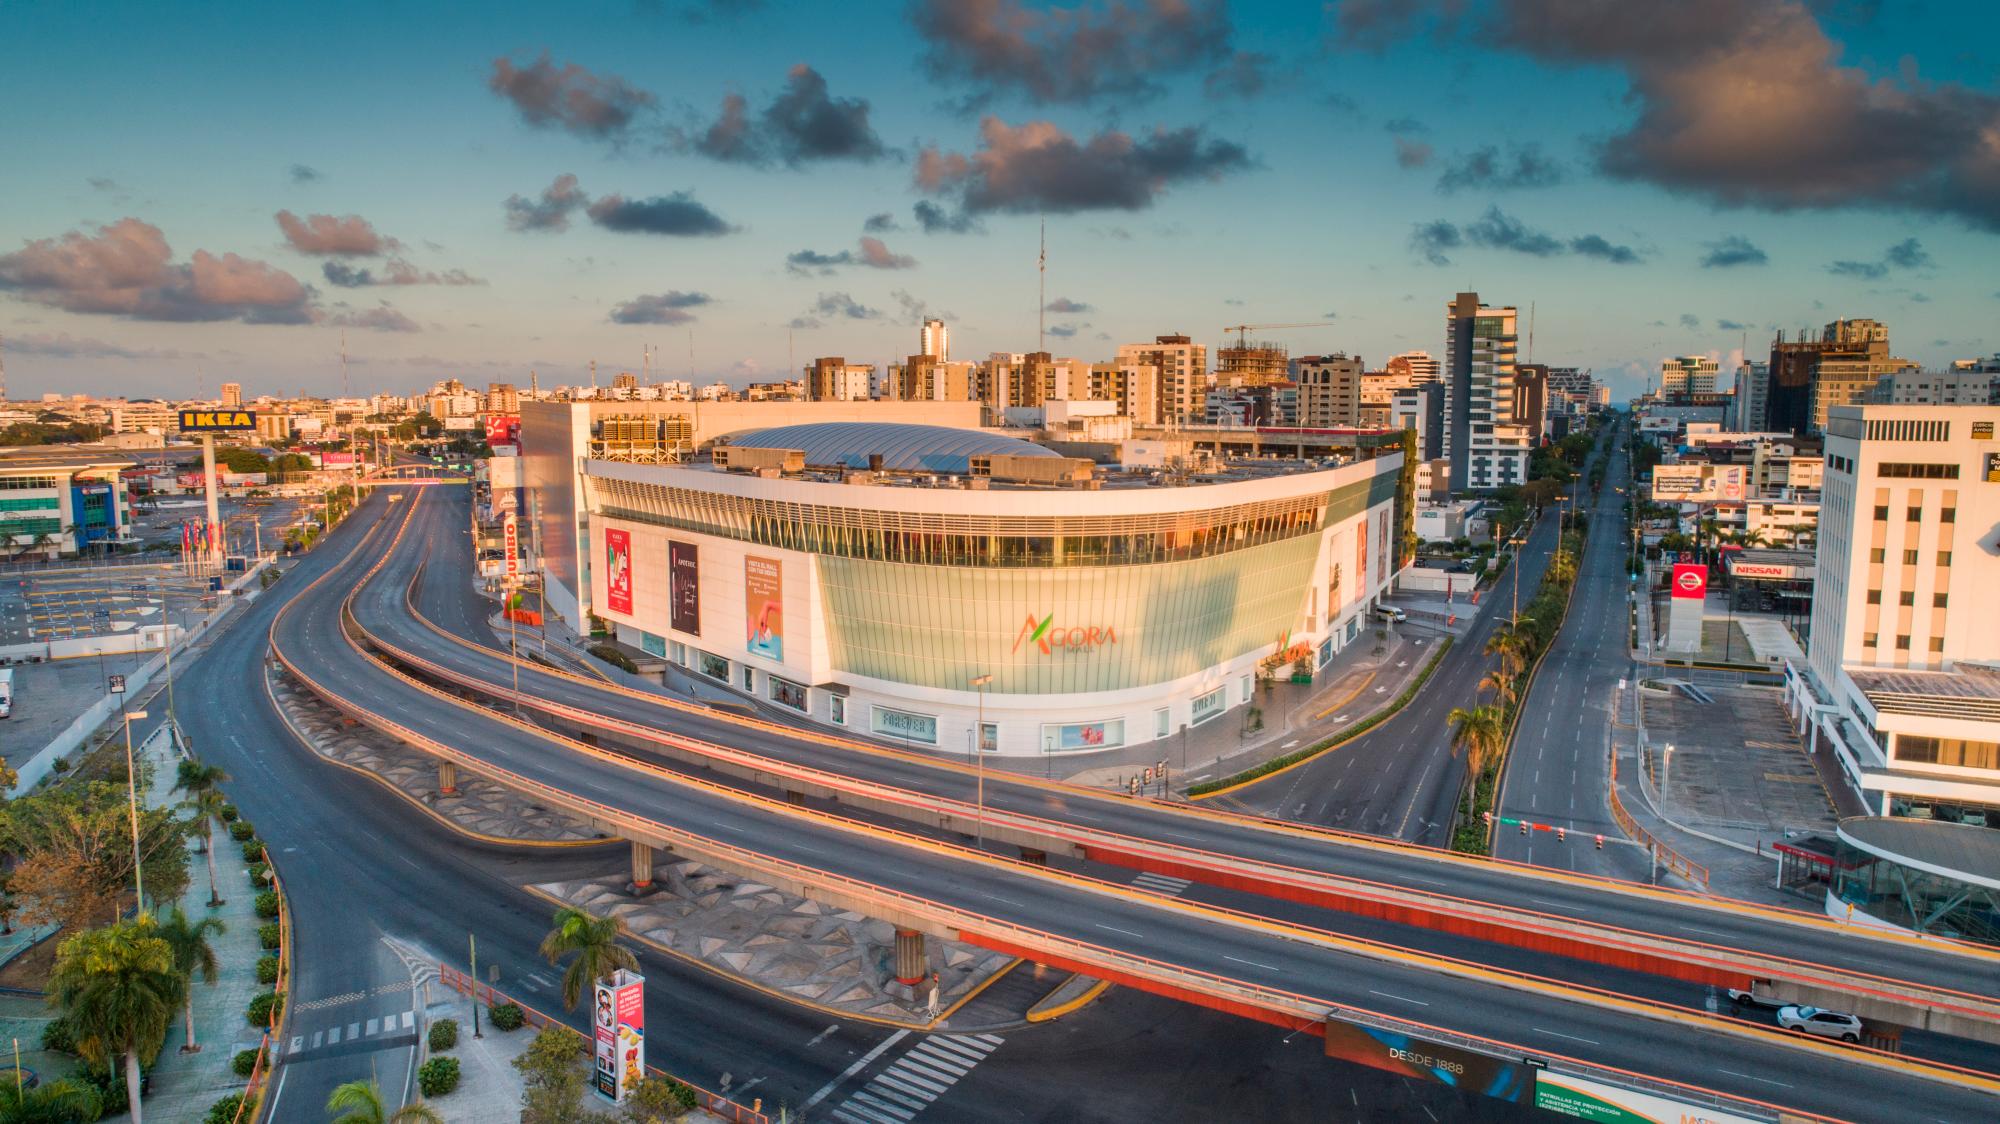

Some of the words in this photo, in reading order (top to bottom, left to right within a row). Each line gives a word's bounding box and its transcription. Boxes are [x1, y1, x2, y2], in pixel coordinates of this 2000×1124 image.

[184, 413, 252, 427] IKEA
[507, 524, 517, 577] JUMBO
[1736, 566, 1782, 575] NISSAN
[883, 712, 925, 732] FOREVER
[1389, 1047, 1433, 1067] DESDE
[1435, 1058, 1464, 1075] 1888
[1540, 1092, 1572, 1103] PATRULLAS
[1545, 1099, 1579, 1111] ASISTENCIA
[1579, 1107, 1594, 1116] VIAL
